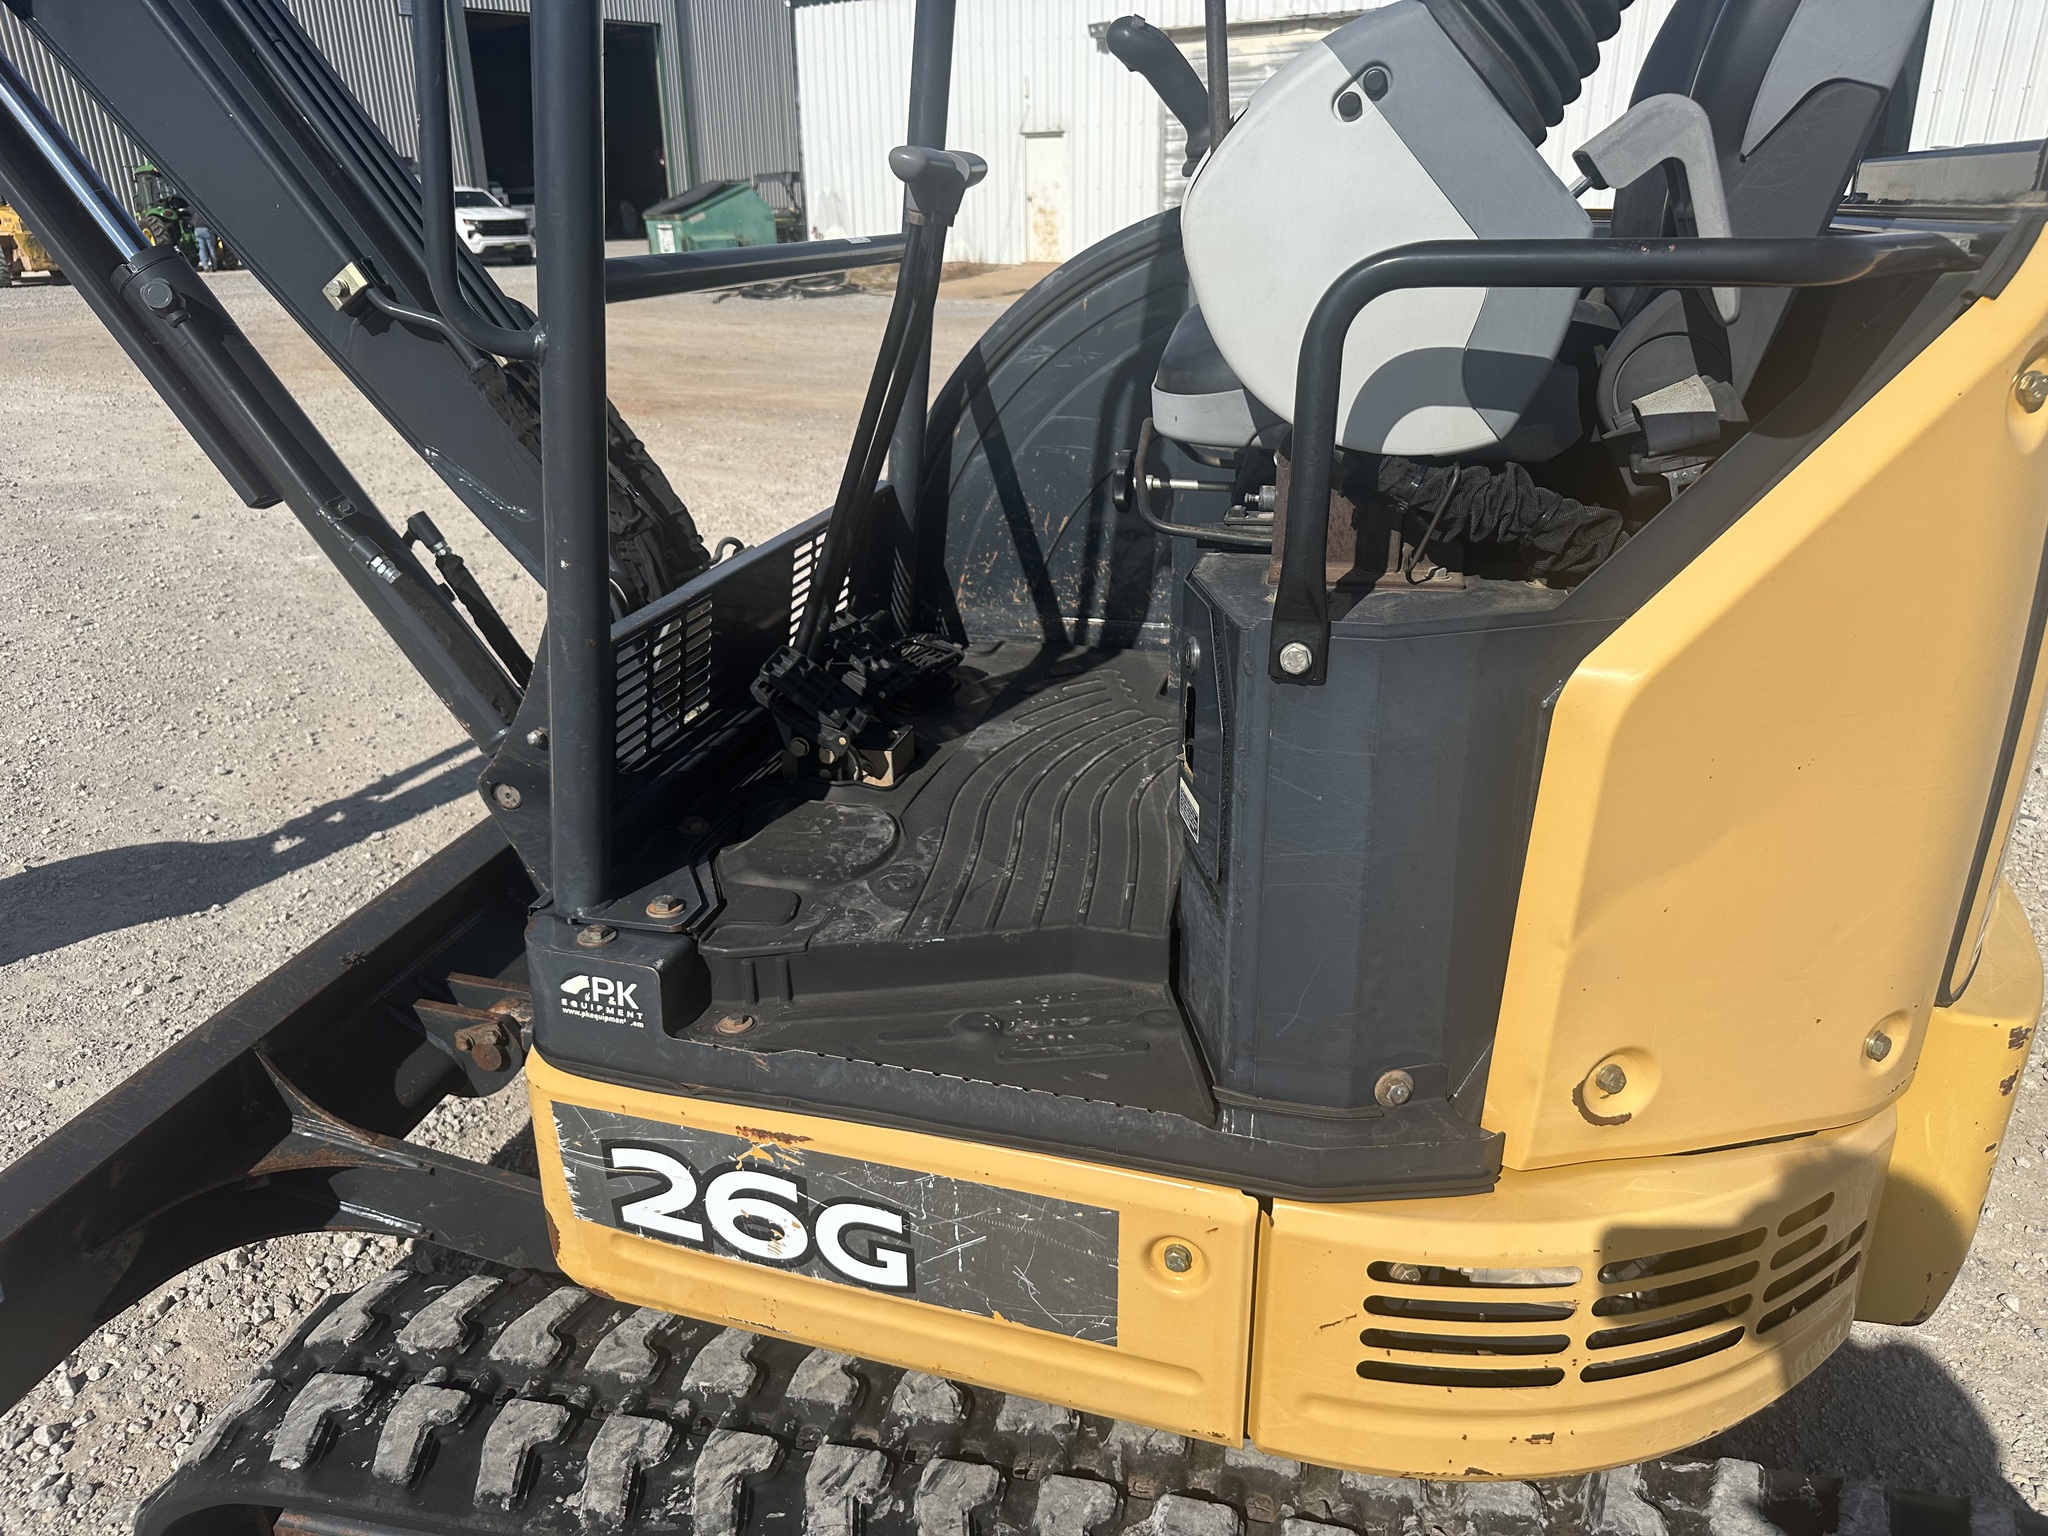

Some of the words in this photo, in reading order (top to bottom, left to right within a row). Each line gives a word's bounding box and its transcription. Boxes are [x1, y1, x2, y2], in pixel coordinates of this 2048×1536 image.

[561, 998, 644, 1020] EQUIPMENT
[561, 1007, 645, 1028] www.pkequipmentom
[609, 1147, 910, 1288] 26G
